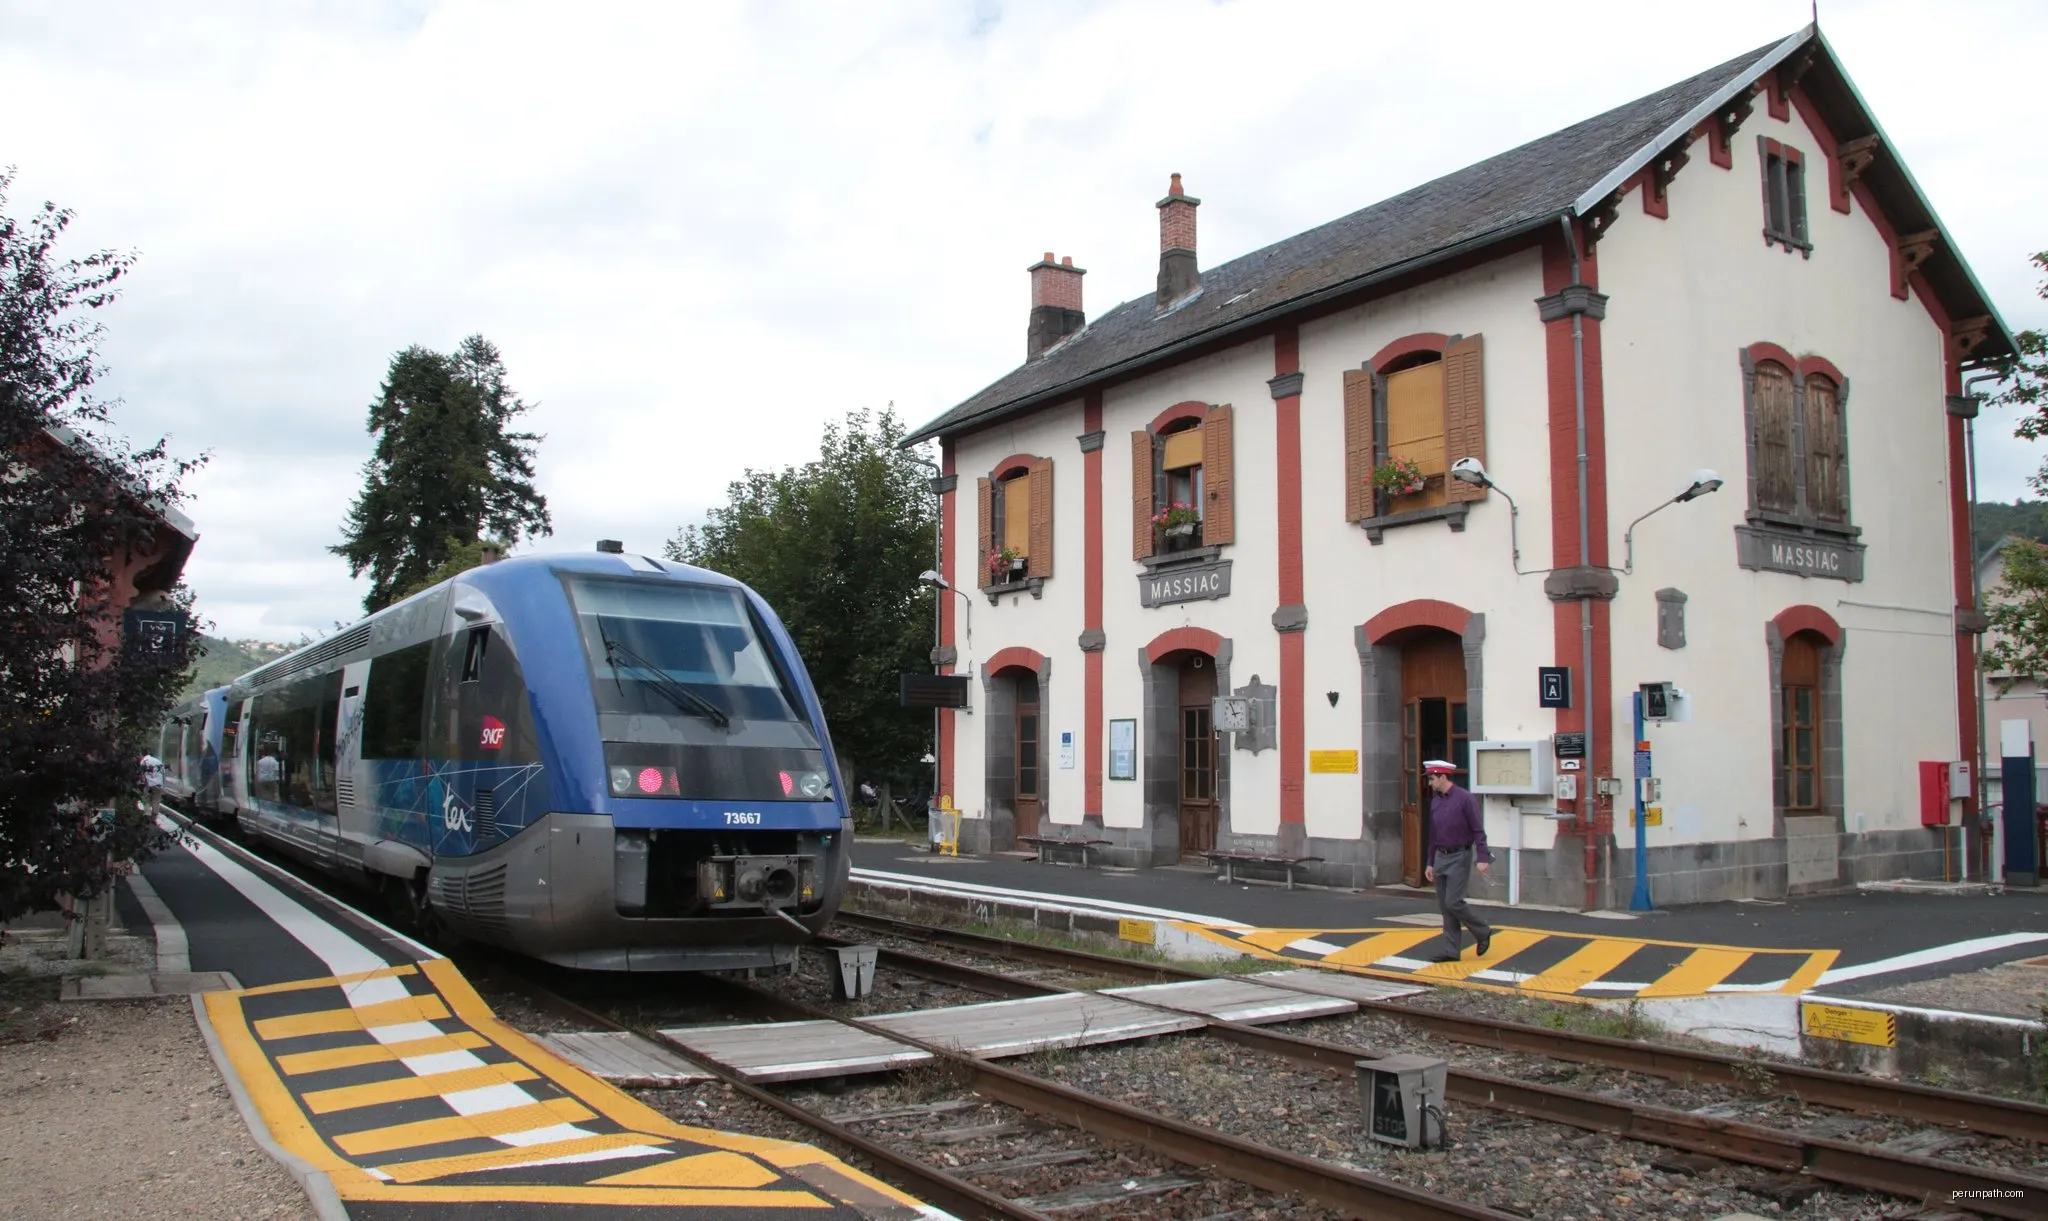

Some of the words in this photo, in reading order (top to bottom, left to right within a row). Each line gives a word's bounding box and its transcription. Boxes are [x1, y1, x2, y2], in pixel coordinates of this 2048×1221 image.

[1771, 543, 1839, 571] MASSIAC
[1151, 573, 1219, 599] MASSIAC
[1548, 684, 1557, 697] A
[481, 728, 505, 744] SNCF
[443, 782, 473, 833] ter
[723, 812, 761, 825] 73667
